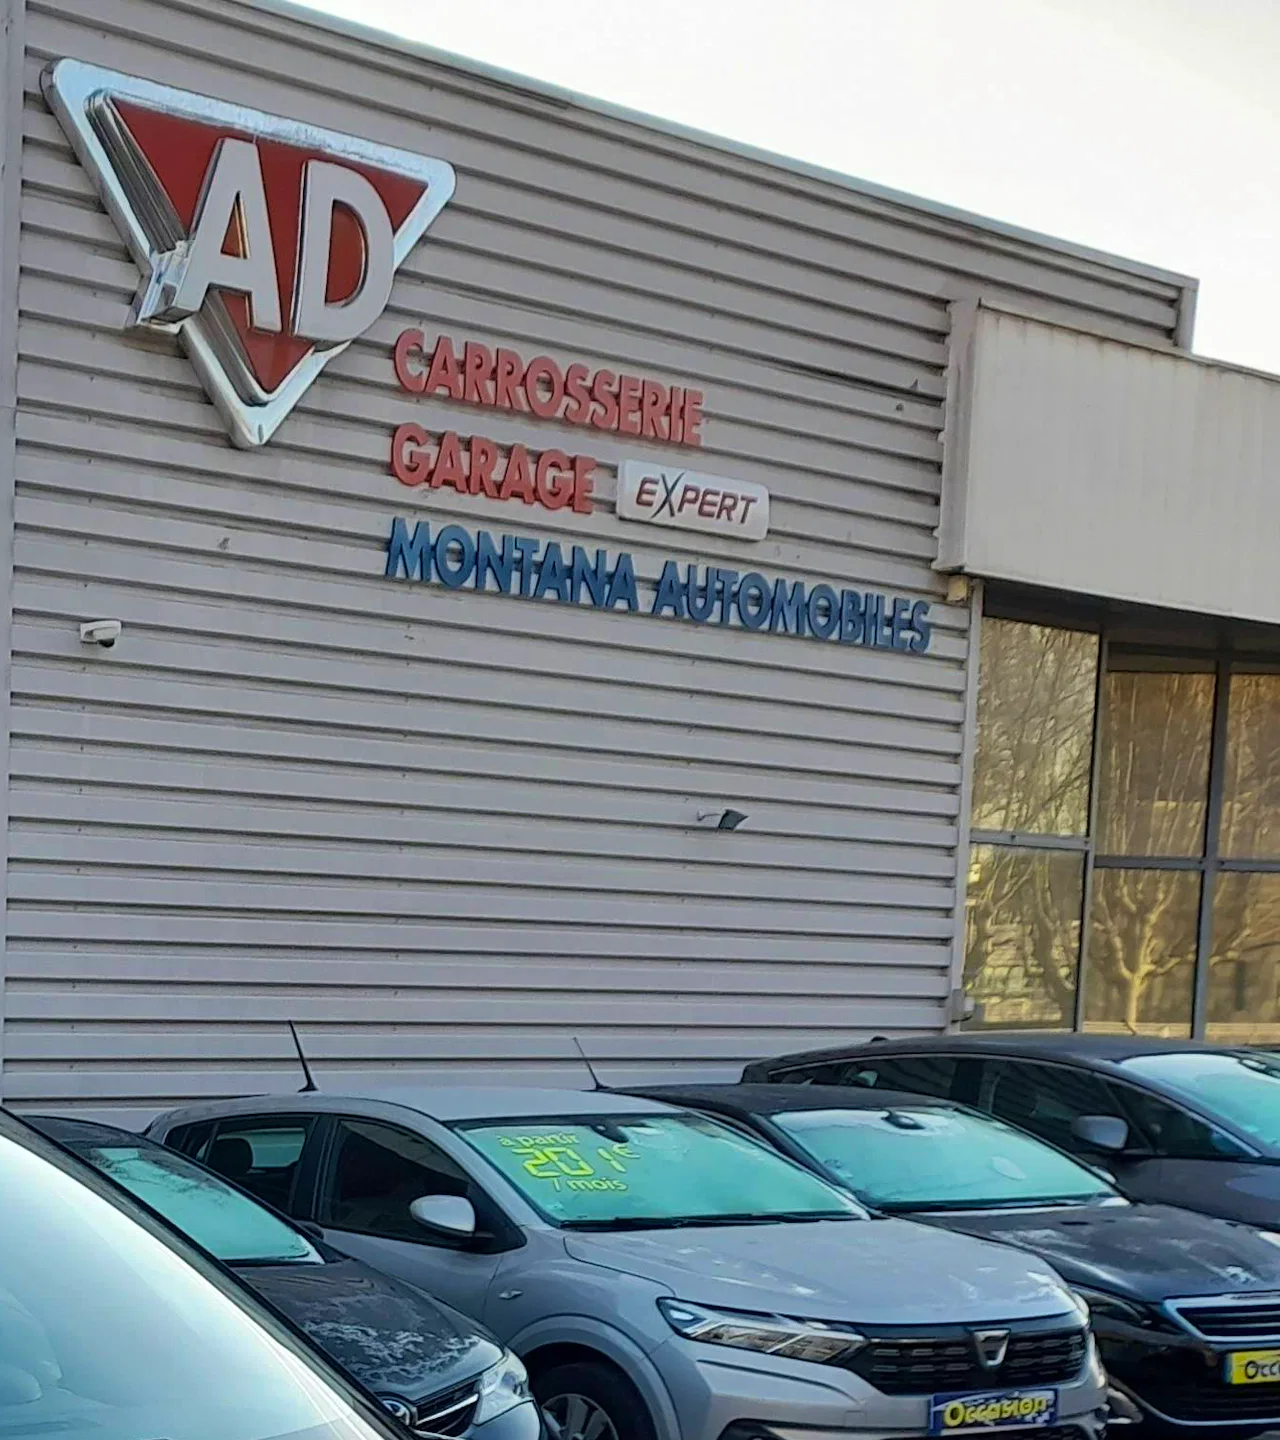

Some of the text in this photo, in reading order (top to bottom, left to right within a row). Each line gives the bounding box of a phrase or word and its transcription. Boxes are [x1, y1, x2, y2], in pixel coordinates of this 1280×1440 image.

[174, 136, 395, 342] AD
[394, 328, 704, 447] CARROSSERIE
[391, 422, 596, 515] GARAGE
[635, 471, 758, 524] EXPERT
[385, 516, 933, 655] MONTANA AUTOMOBILES
[516, 1132, 580, 1147] partir
[566, 1177, 628, 1192] mois
[943, 1393, 1048, 1428] Occasion
